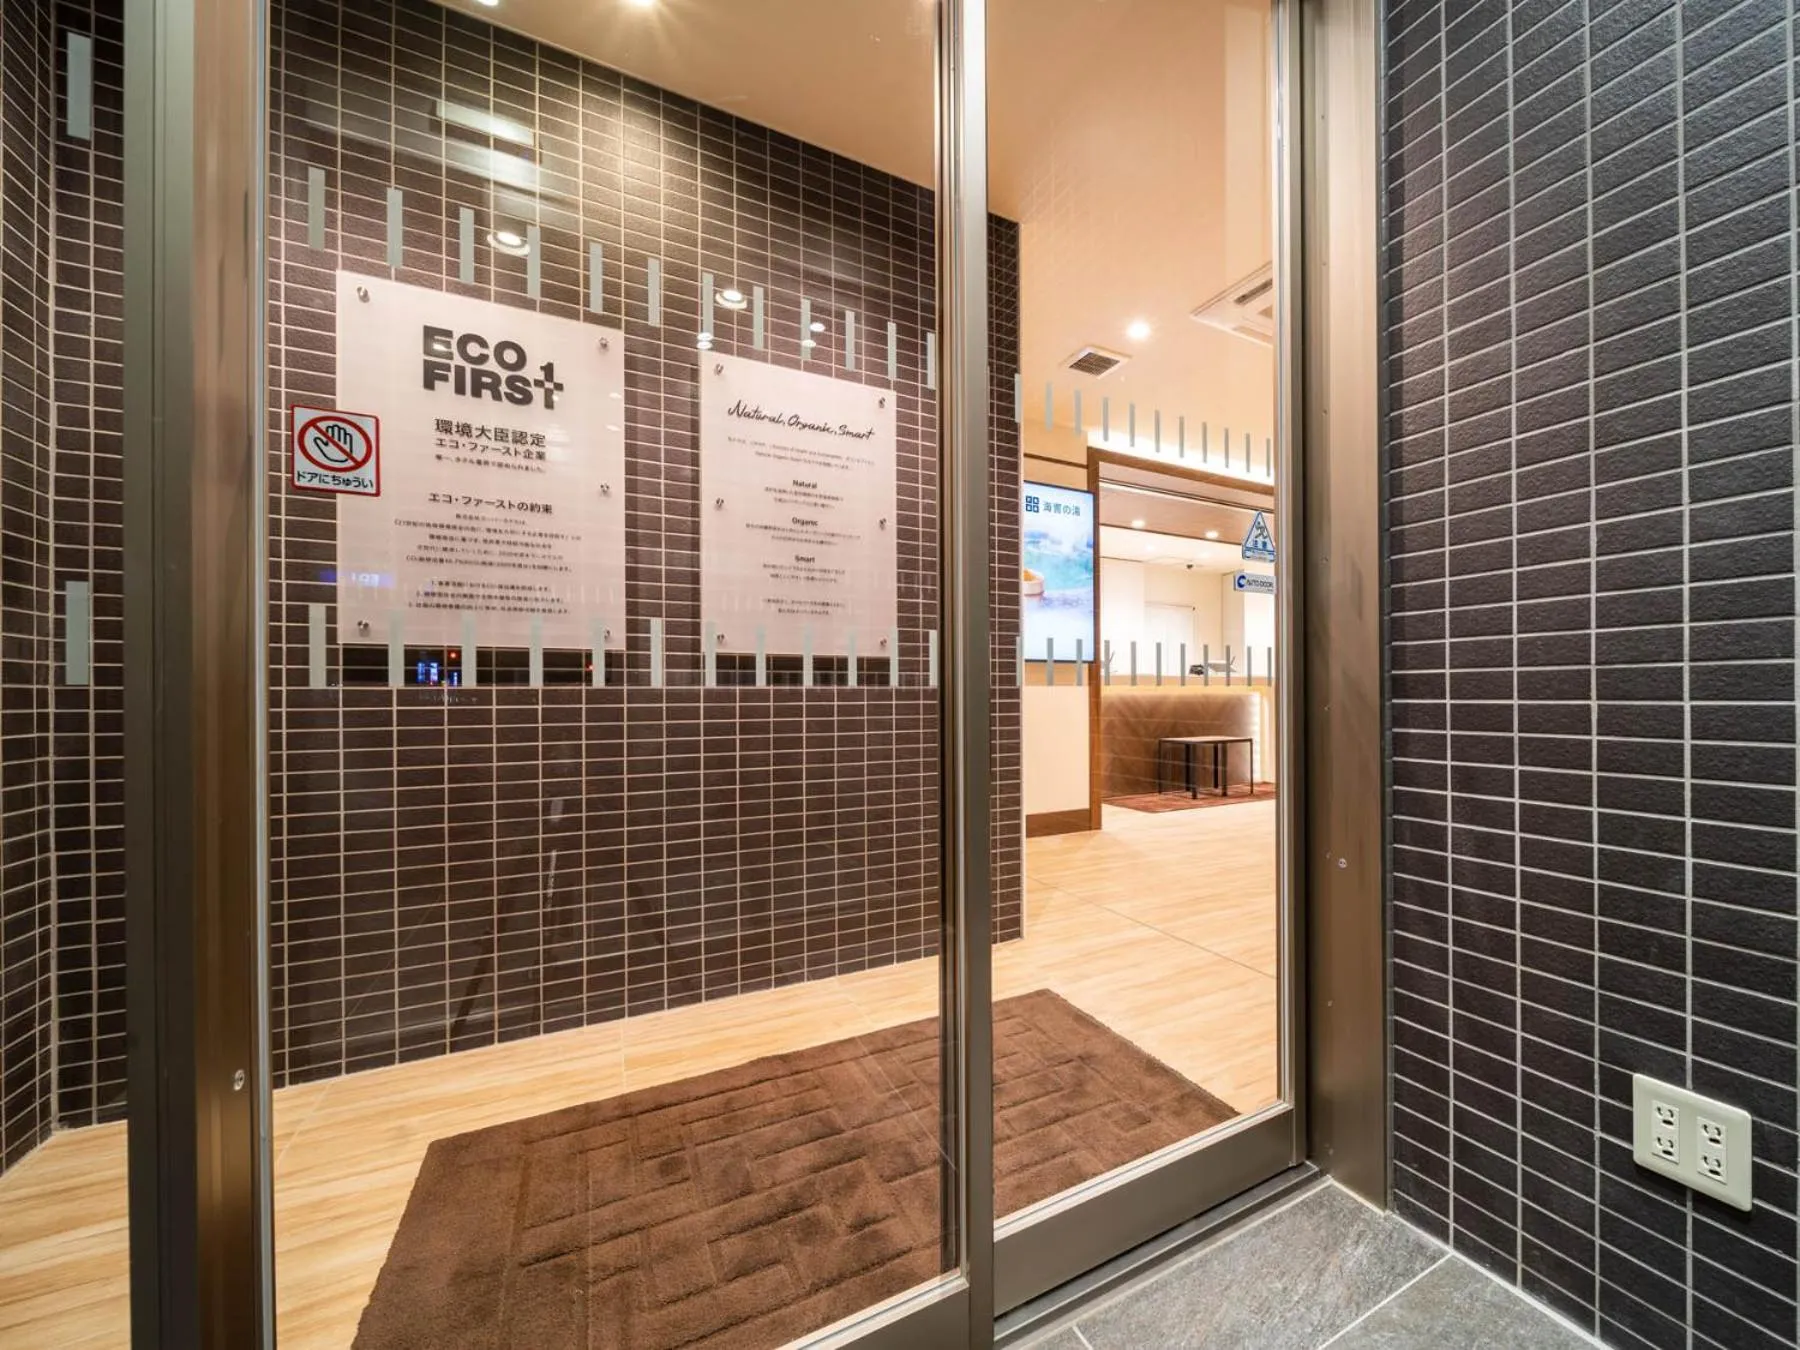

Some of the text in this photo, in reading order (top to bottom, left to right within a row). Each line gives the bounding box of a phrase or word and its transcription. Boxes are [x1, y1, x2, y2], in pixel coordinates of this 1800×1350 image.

[423, 325, 527, 372] ECO
[434, 418, 546, 448] 環境大臣認定
[436, 438, 546, 461] エコ・ファースト企業
[296, 470, 374, 489] ドアにちゅうい
[428, 491, 553, 515] エコ・ファーストの約束
[791, 516, 818, 527] Organic
